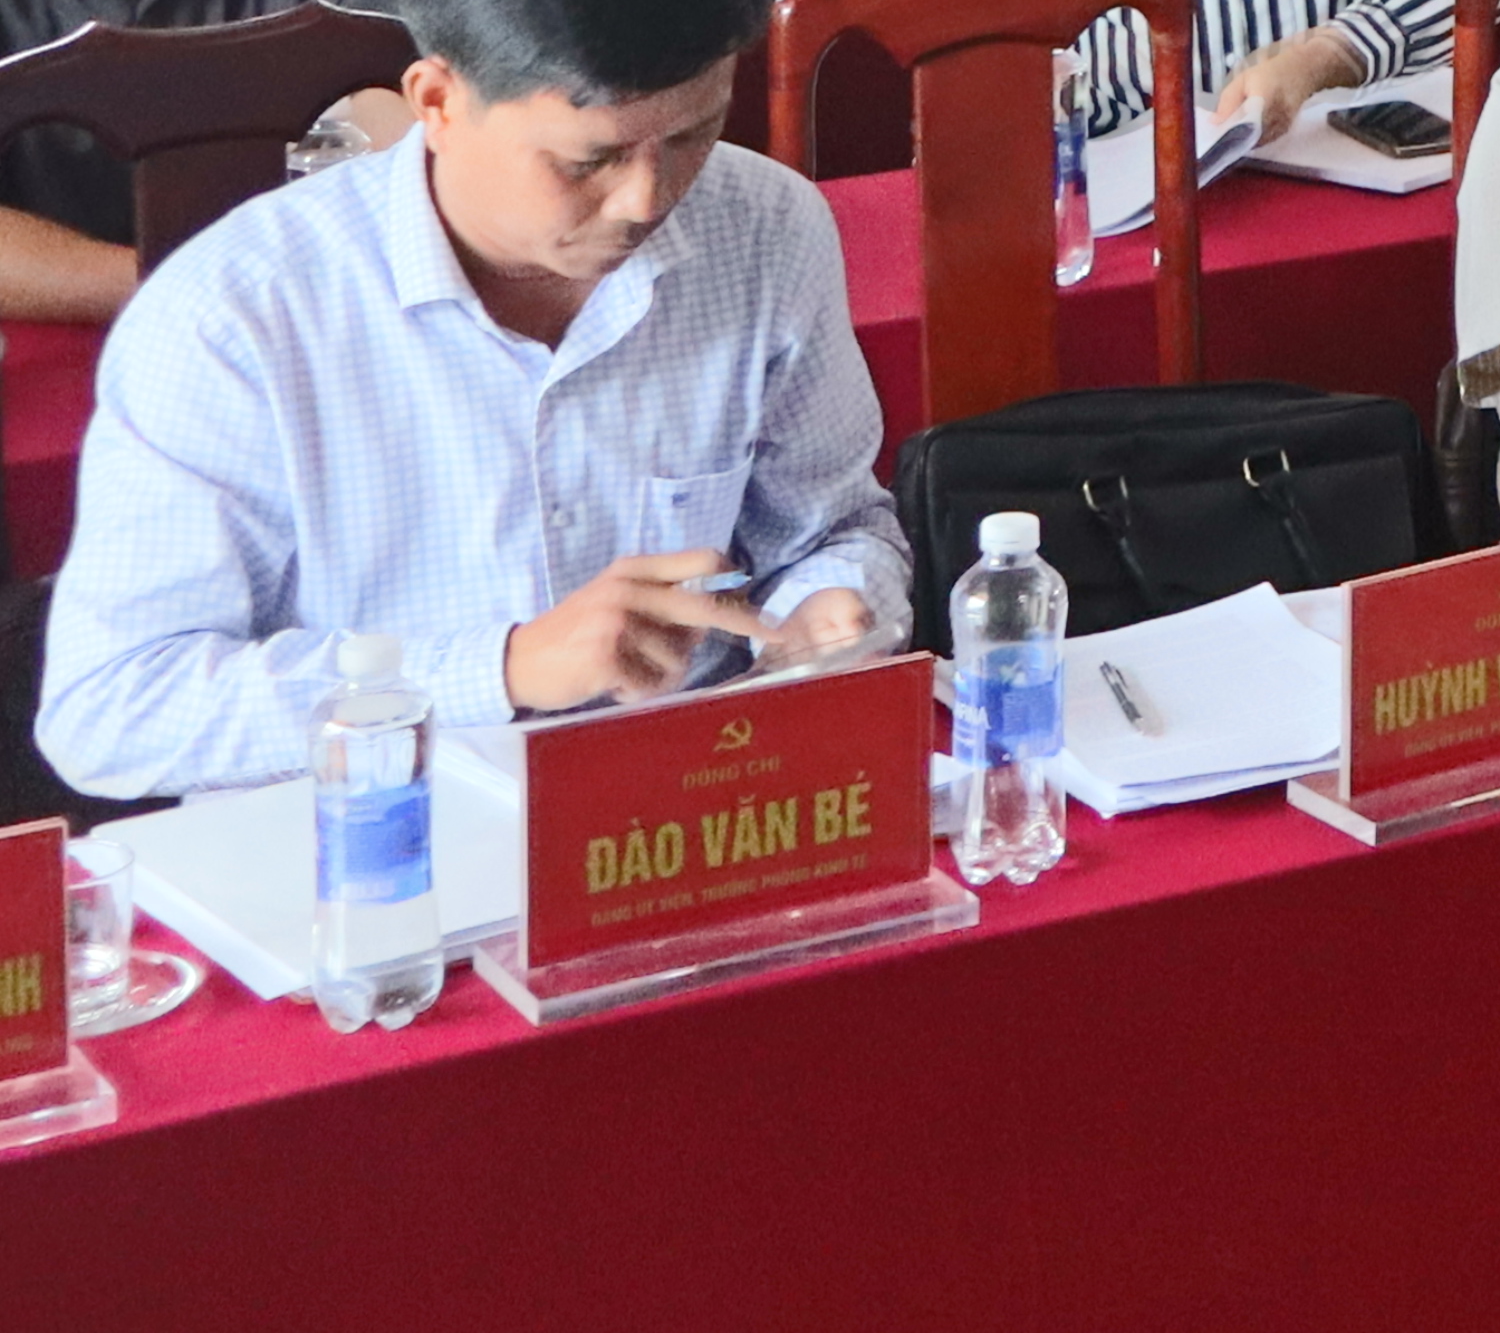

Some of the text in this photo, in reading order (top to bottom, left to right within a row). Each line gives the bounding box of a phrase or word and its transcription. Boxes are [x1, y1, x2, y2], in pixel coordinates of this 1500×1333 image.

[1374, 659, 1488, 735] HUỲNH
[585, 770, 873, 895] ĐÀO VĂN BÉ
